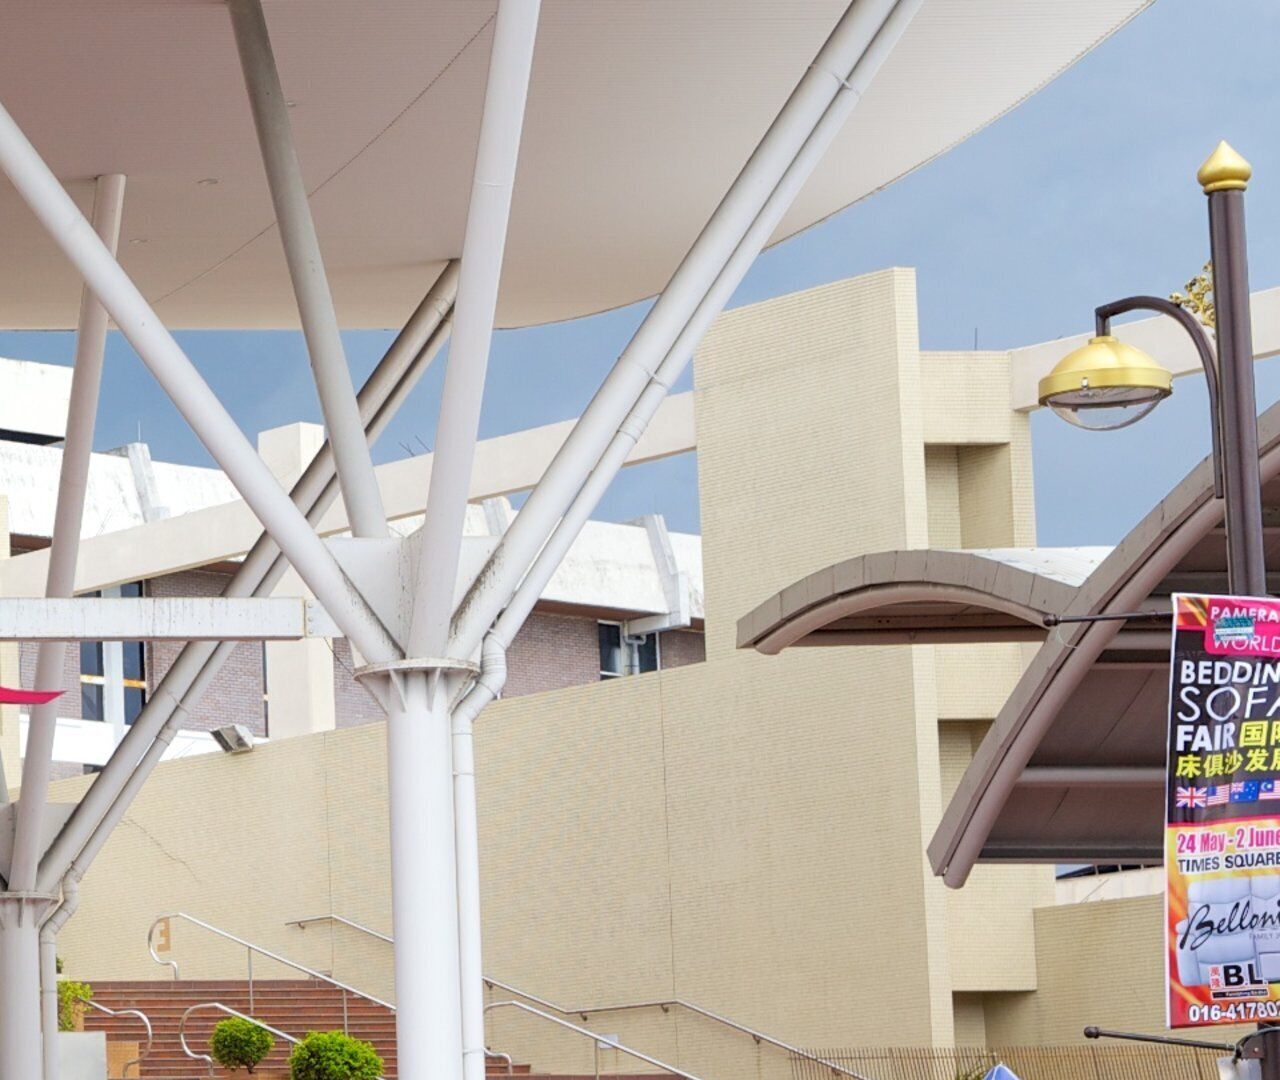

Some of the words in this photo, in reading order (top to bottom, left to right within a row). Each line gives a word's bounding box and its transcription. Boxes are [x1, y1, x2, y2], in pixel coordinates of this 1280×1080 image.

[1180, 660, 1280, 685] BEDDIN
[1175, 721, 1236, 752] FAIR
[1177, 833, 1197, 854] 24
[1200, 831, 1226, 853] May
[1236, 828, 1245, 849] 2
[1177, 856, 1221, 873] TIMES
